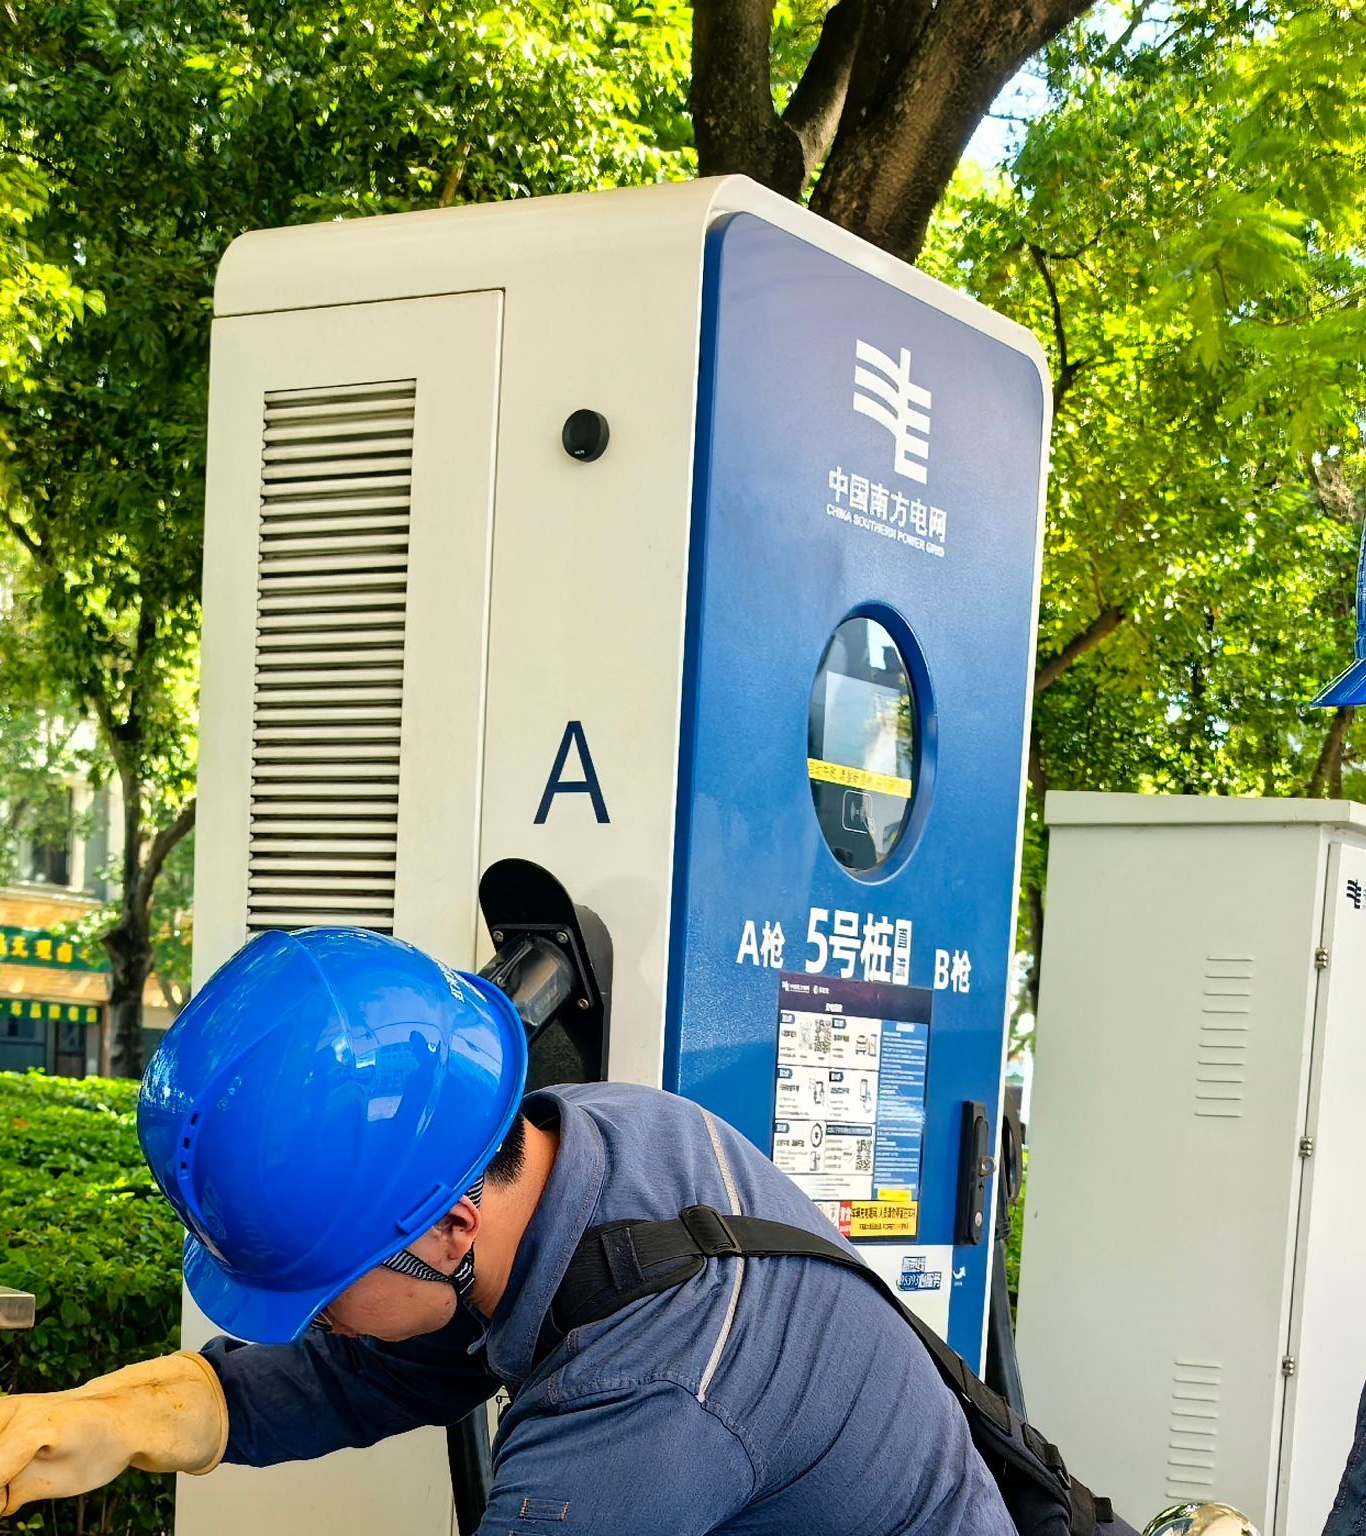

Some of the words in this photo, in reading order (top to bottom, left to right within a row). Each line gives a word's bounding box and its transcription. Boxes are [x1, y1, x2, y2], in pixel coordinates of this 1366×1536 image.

[826, 503, 852, 523] CHINA
[853, 513, 897, 540] SOUTHERN
[897, 530, 926, 552] POWER
[828, 466, 947, 543] 中国南方电网
[533, 720, 611, 824] A
[735, 919, 785, 969] A枪
[933, 948, 972, 993] B枪
